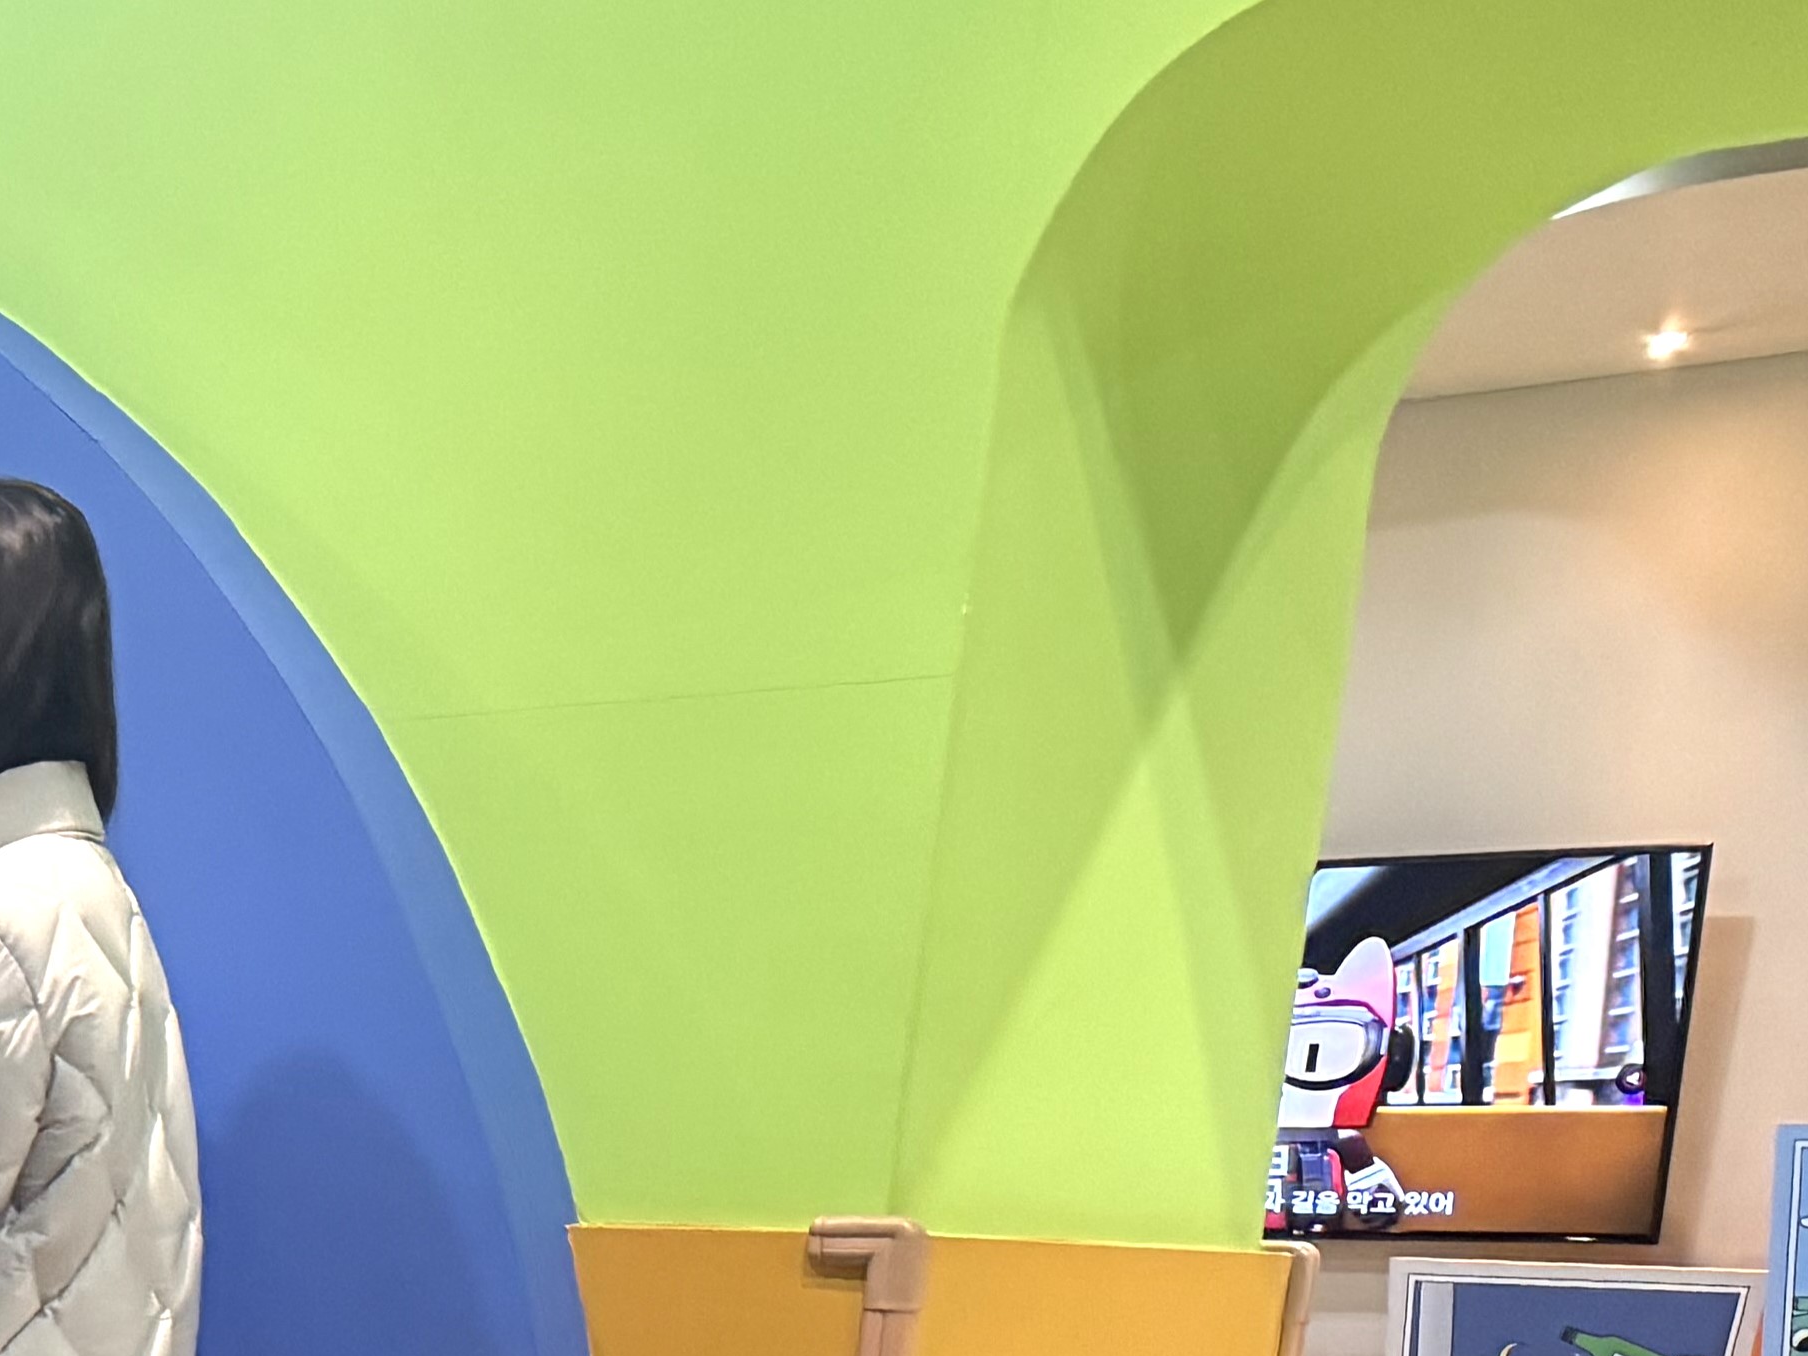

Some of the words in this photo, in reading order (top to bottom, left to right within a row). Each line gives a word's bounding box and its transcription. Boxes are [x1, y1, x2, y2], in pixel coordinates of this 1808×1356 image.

[1291, 1190, 1340, 1214] 길을
[1346, 1190, 1397, 1215] 막고
[1404, 1191, 1455, 1216] 있어
